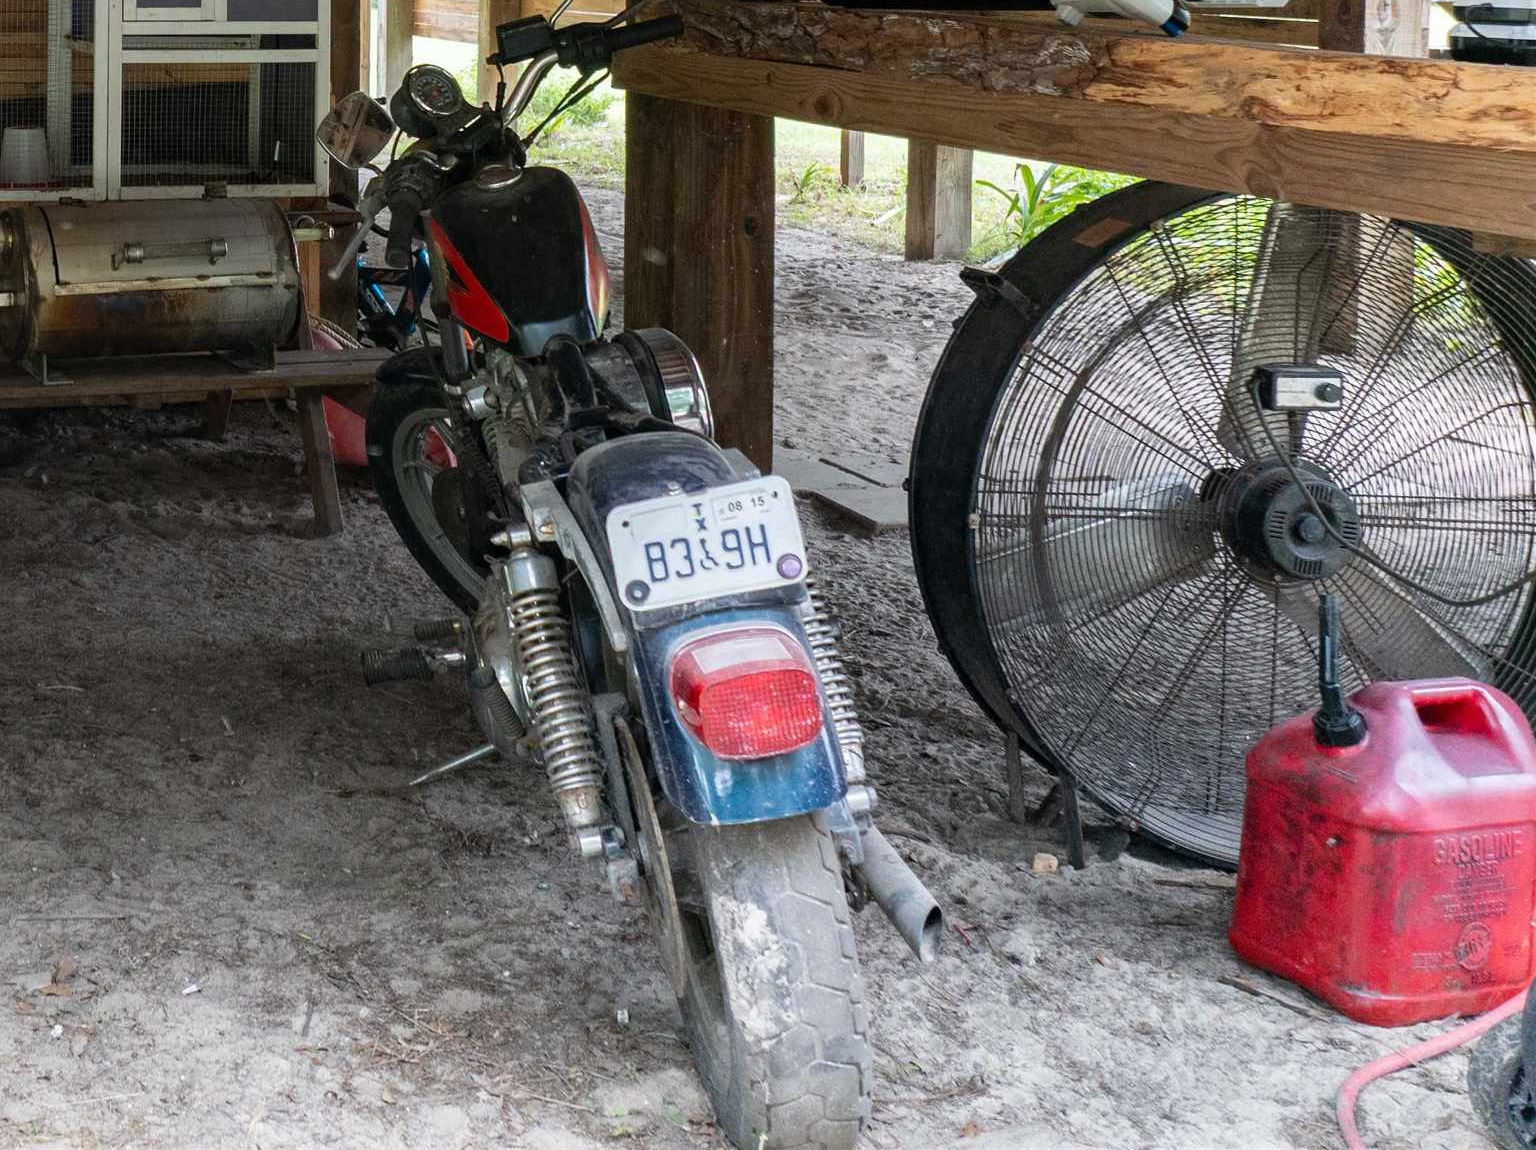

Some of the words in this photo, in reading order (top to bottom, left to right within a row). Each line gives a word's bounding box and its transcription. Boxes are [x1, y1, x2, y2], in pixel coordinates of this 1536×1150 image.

[727, 500, 743, 513] 08
[751, 496, 766, 508] 15
[1432, 828, 1523, 866] GASOLINE
